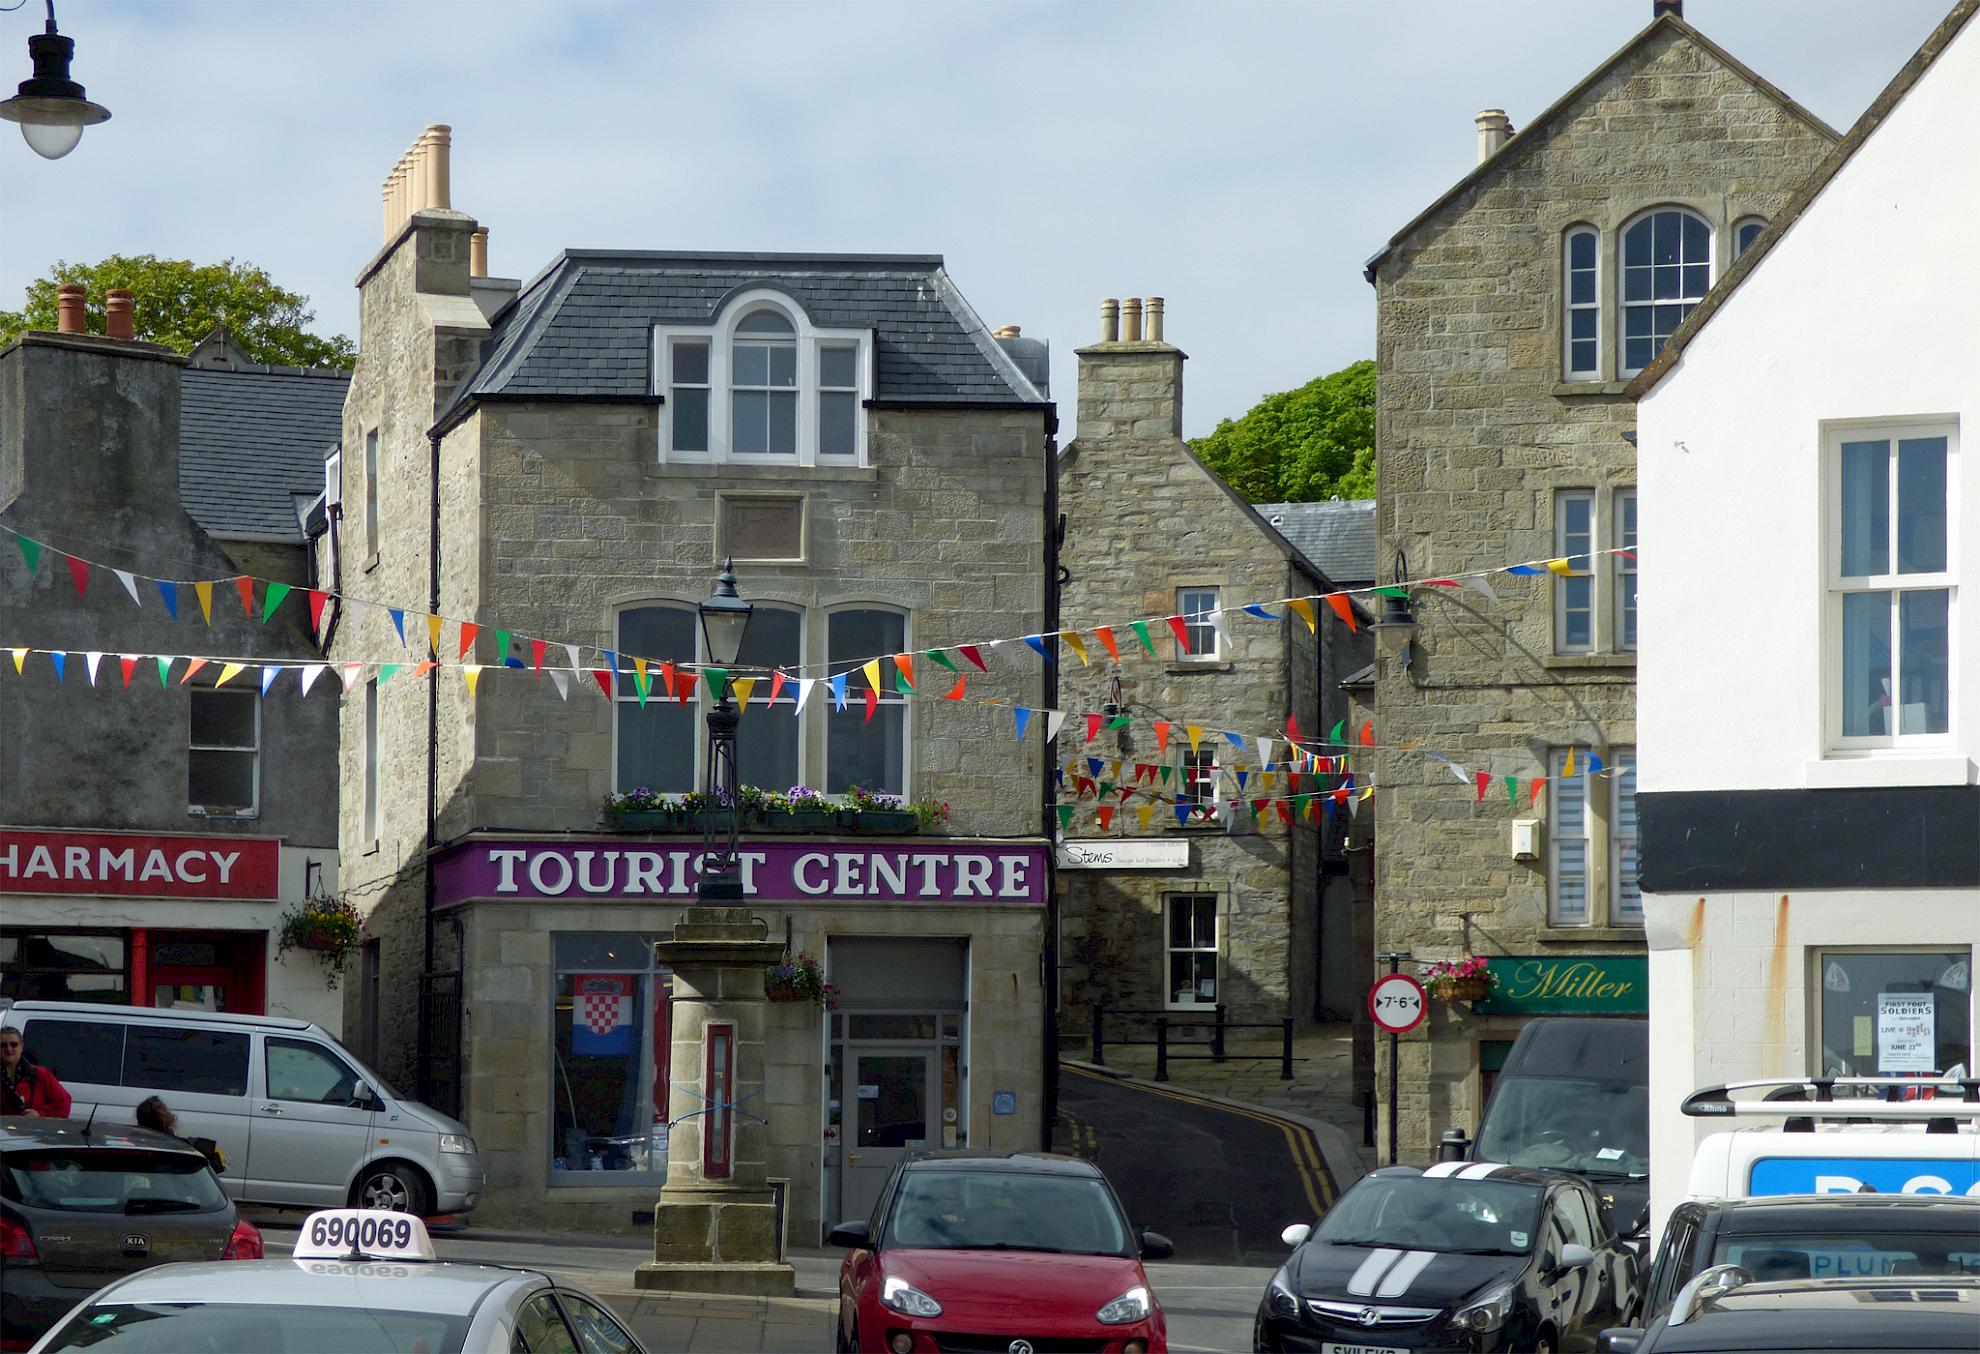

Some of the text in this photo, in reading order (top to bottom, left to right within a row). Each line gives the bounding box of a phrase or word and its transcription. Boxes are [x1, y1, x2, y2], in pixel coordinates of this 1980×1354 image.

[1065, 846, 1114, 864] Stems
[792, 853, 1030, 897] CENTRE
[1508, 961, 1633, 999] Miller
[1880, 1006, 1932, 1015] SOLDIERS
[125, 1236, 145, 1246] KIA
[311, 1217, 411, 1249] 690069
